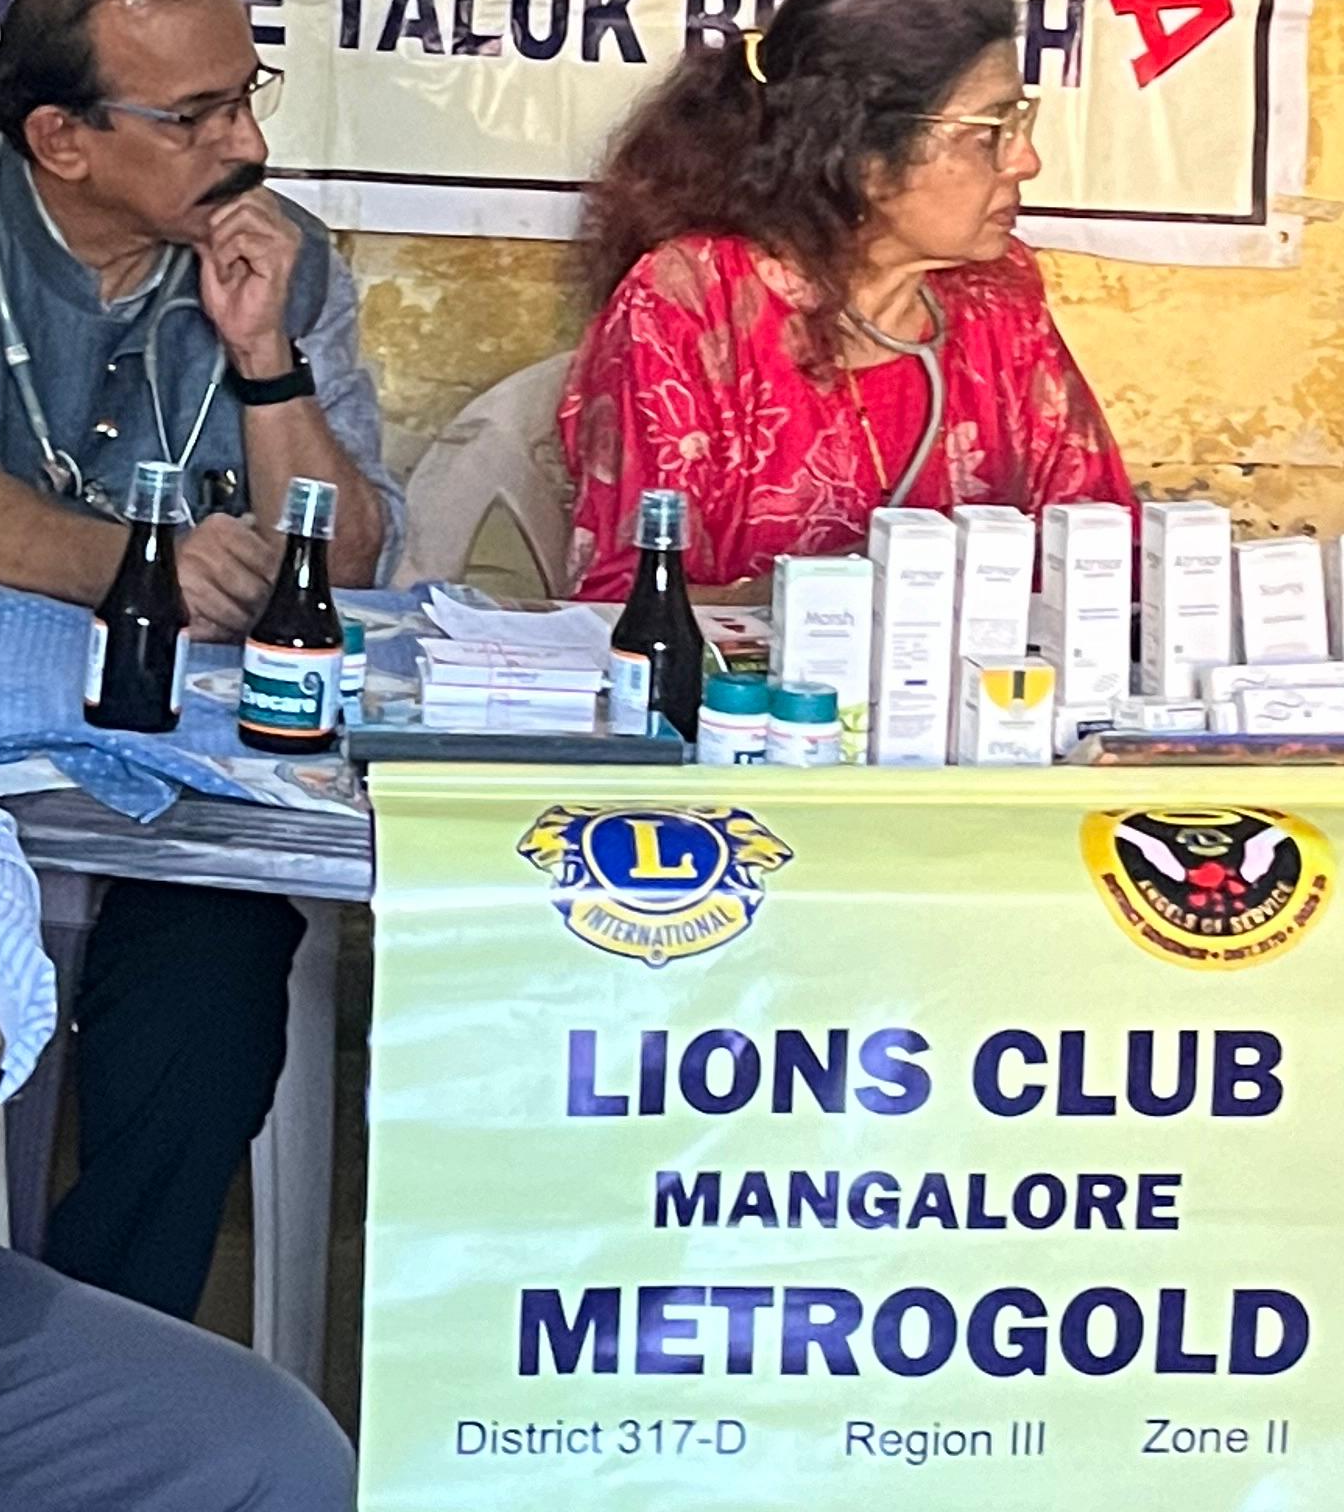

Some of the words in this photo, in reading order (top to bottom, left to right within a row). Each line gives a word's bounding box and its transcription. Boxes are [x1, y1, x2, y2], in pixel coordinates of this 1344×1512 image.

[626, 819, 697, 878] L
[581, 904, 737, 948] INTERNATIONAL
[566, 1028, 931, 1118] LIONS
[972, 1028, 1284, 1118] CLUB
[653, 1170, 1183, 1231] MANGALORE
[516, 1286, 1311, 1378] METROGOLD
[455, 1419, 604, 1458] District
[617, 1420, 747, 1457] 317-D
[845, 1420, 994, 1467] Region
[1009, 1420, 1047, 1457] III
[1142, 1419, 1249, 1455] Zone
[1266, 1419, 1290, 1455] II
